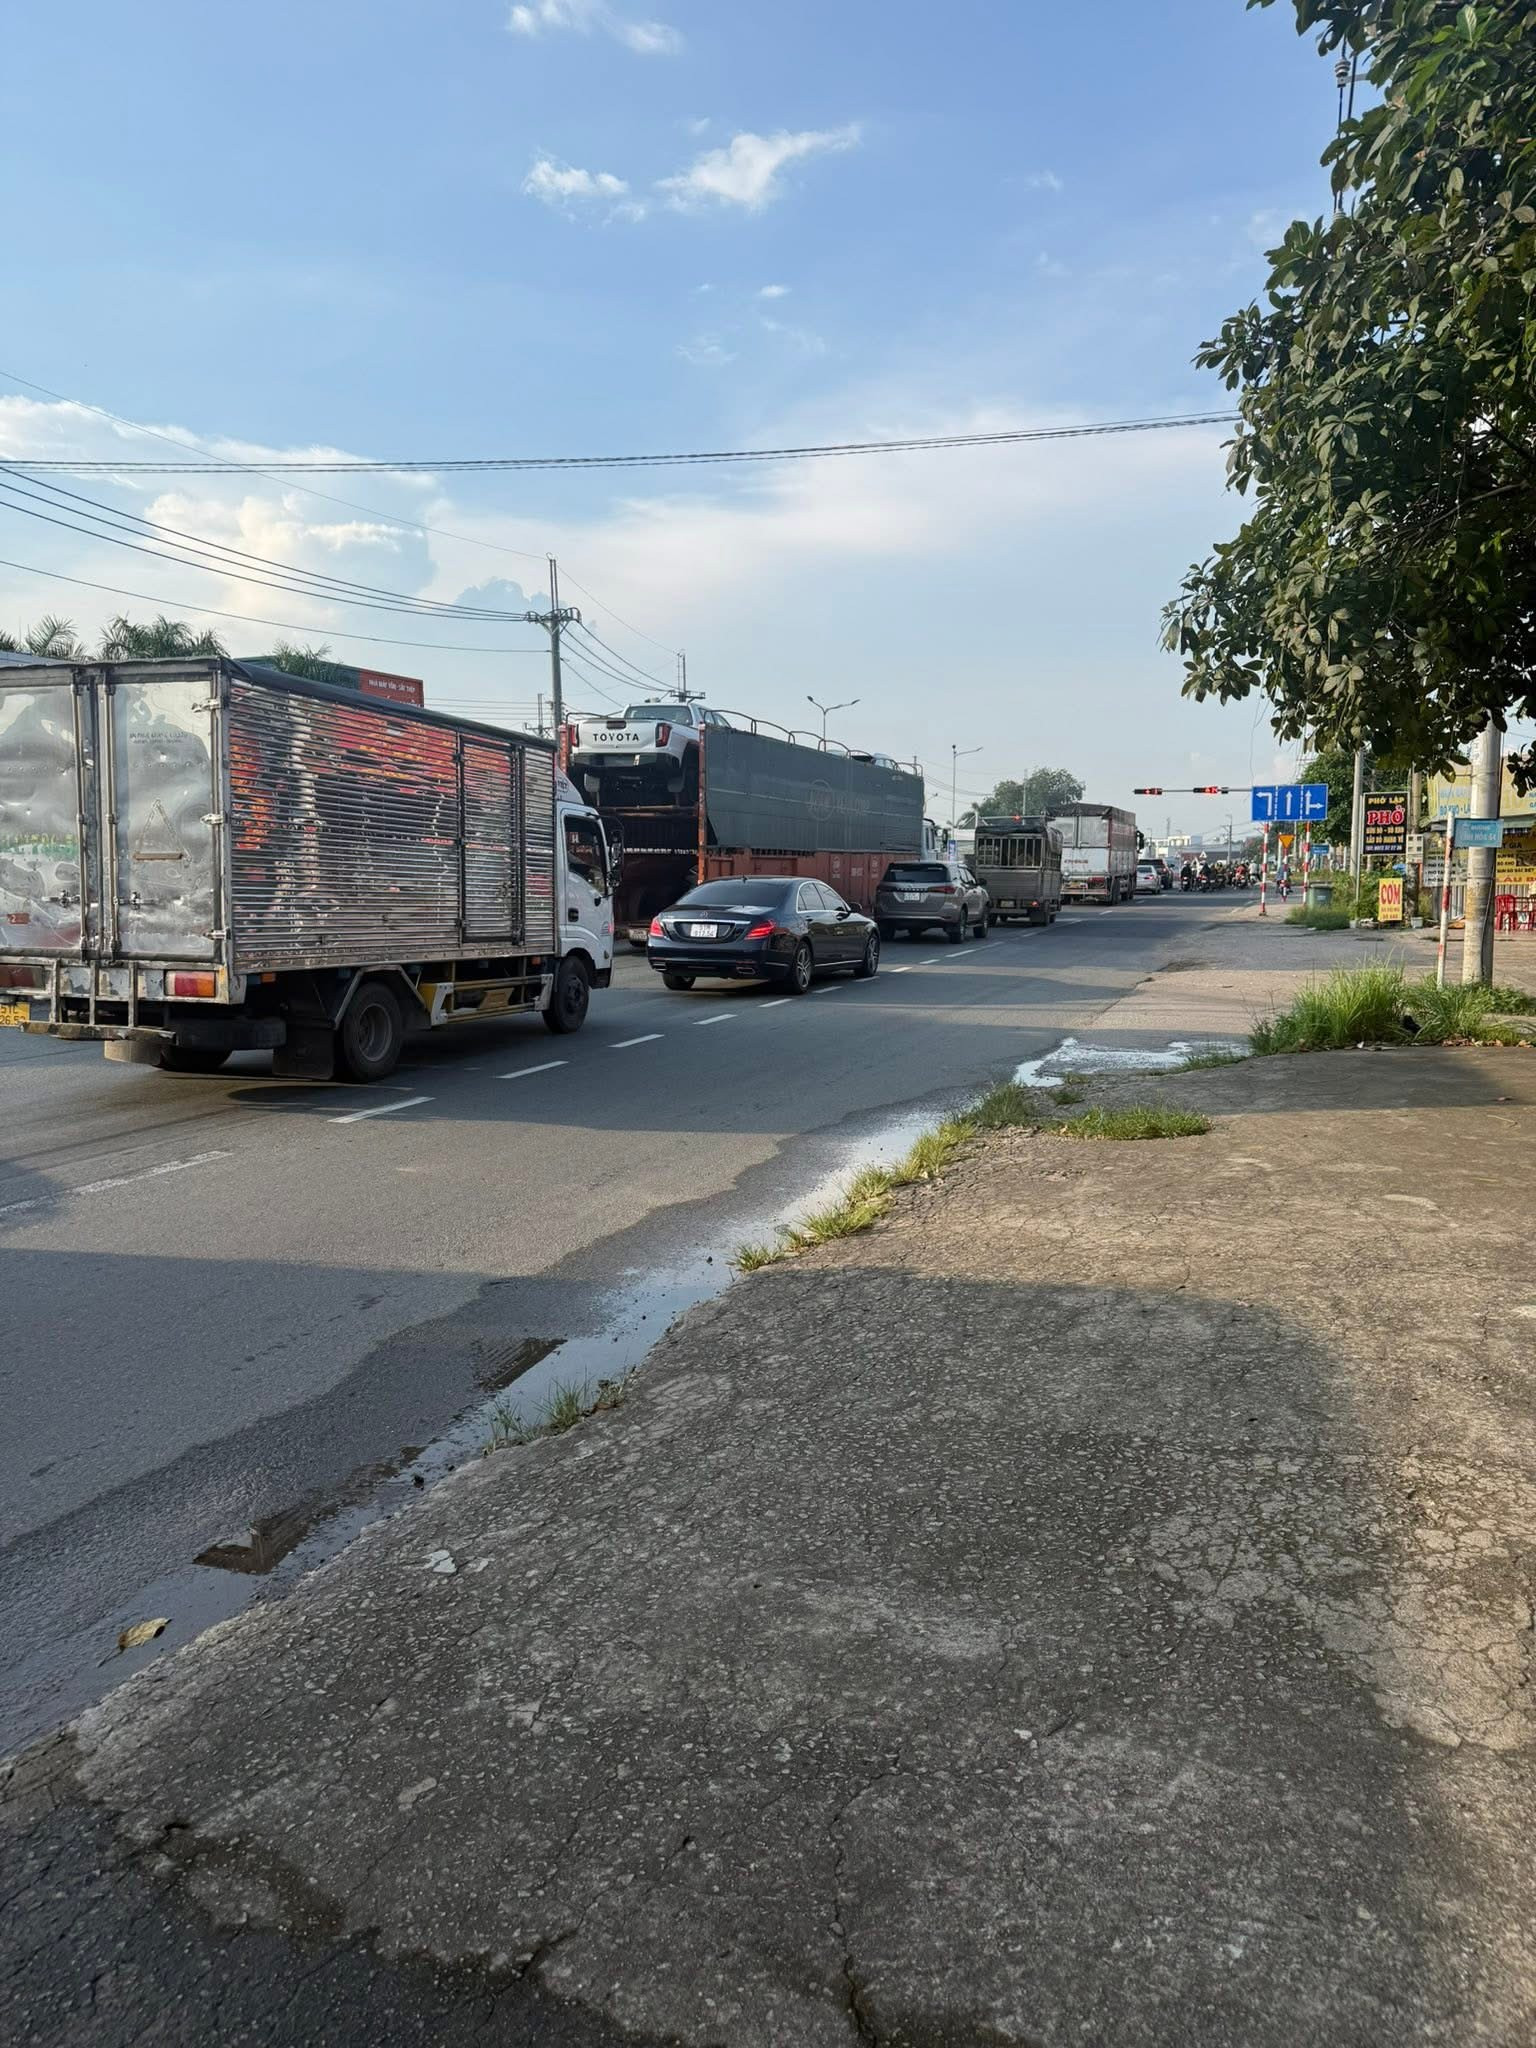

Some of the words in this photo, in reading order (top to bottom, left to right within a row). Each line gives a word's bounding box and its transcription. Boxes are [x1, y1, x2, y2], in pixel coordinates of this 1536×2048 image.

[593, 733, 640, 742] TOYOTA
[1367, 805, 1405, 825] PHỞ
[1381, 880, 1401, 905] CƠM
